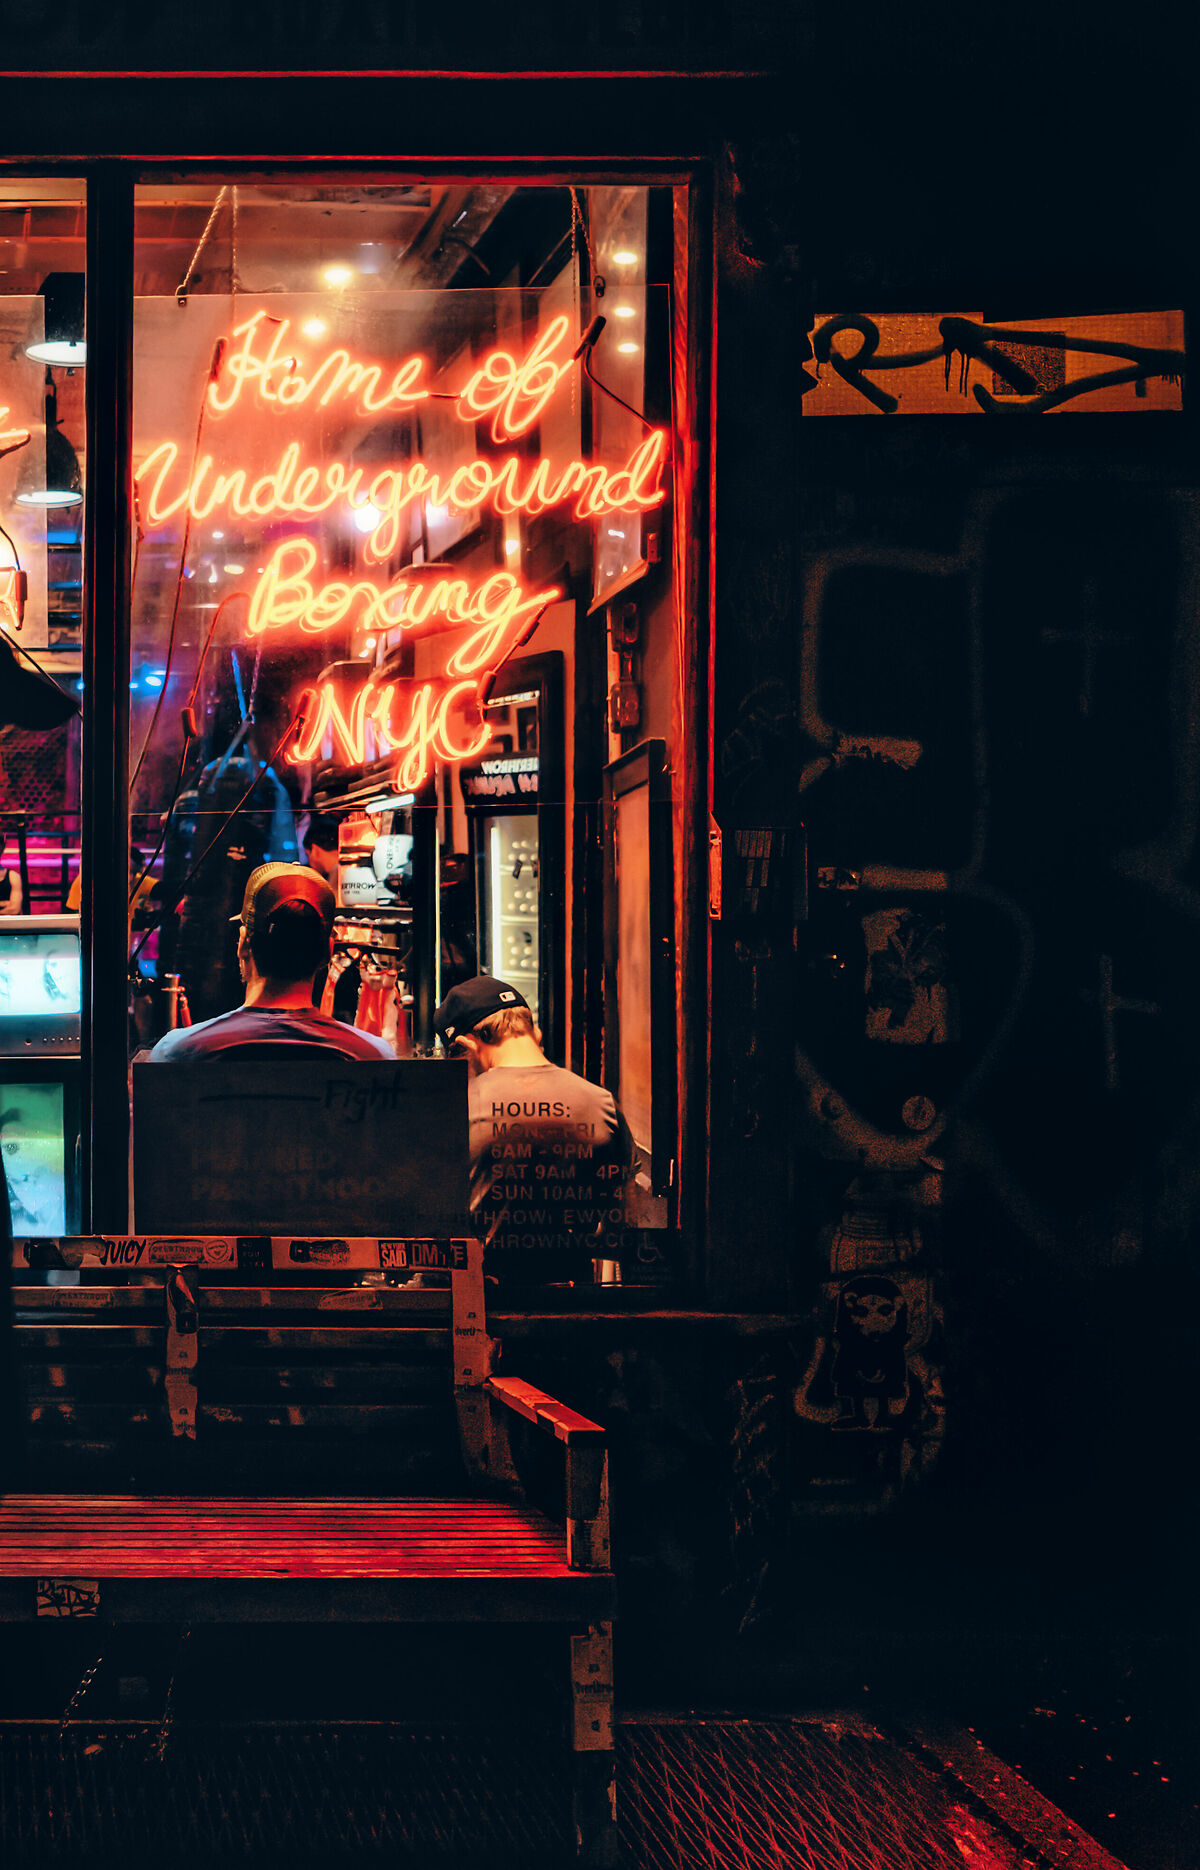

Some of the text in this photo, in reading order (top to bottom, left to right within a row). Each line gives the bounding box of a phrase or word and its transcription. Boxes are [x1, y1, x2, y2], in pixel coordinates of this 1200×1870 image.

[208, 311, 572, 440] Home of
[135, 430, 665, 562] Underground
[247, 537, 560, 675] Boxing
[286, 681, 493, 793] NYC
[324, 1070, 407, 1124] Fight
[491, 1101, 571, 1118] HOURS:
[491, 1163, 529, 1180] SAT
[491, 1184, 534, 1201] SUN
[542, 1184, 593, 1201] 10AM
[100, 1239, 147, 1266] JUICY
[381, 1249, 407, 1267] SAID
